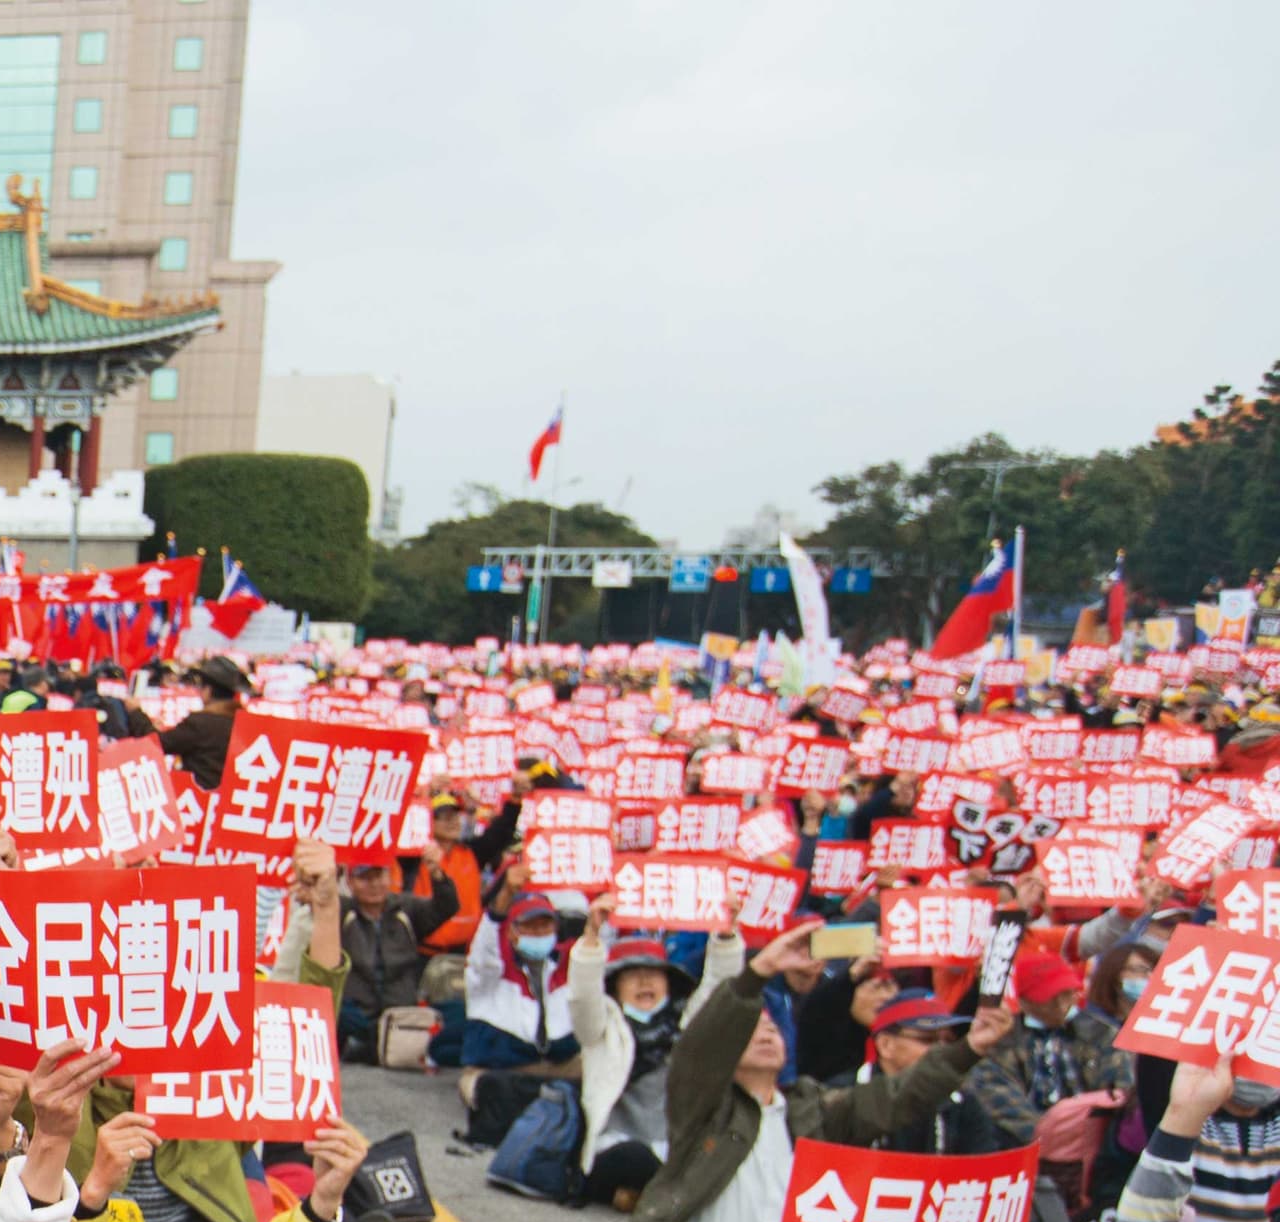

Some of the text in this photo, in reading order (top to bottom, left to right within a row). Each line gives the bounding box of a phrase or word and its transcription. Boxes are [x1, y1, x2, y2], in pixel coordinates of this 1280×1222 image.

[221, 733, 414, 849] 全民遭殃
[1087, 782, 1171, 825] 全民遭殃
[657, 802, 741, 852] 全民遭殃
[868, 825, 945, 869] 全民遭殃
[526, 831, 613, 885] 全民遭殃
[1043, 844, 1140, 898] 全民遭殃
[614, 861, 730, 923] 全民遭殃
[887, 896, 997, 959] 全民遭殃
